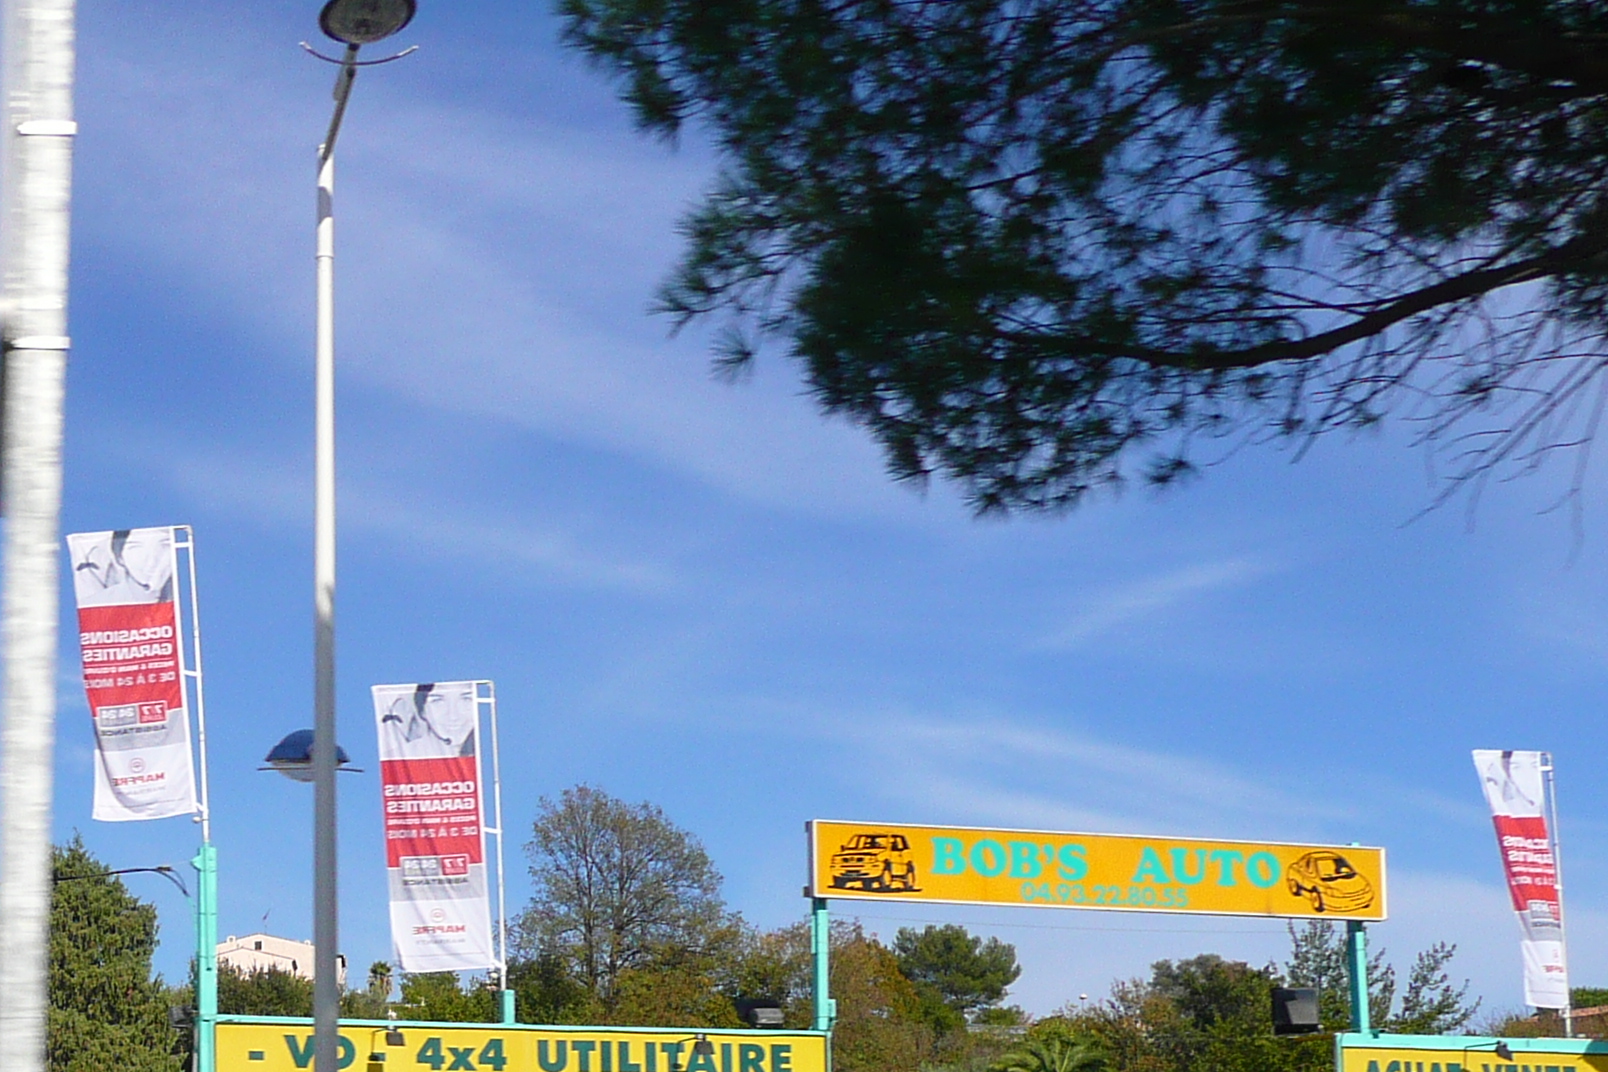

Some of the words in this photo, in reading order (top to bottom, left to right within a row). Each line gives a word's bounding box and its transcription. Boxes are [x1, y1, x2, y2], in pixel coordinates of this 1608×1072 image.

[931, 836, 1089, 881] BOB'S
[1132, 846, 1282, 889] AUTO
[1020, 881, 1189, 907] 04.93.22.80.55
[416, 1037, 507, 1071] 4x4
